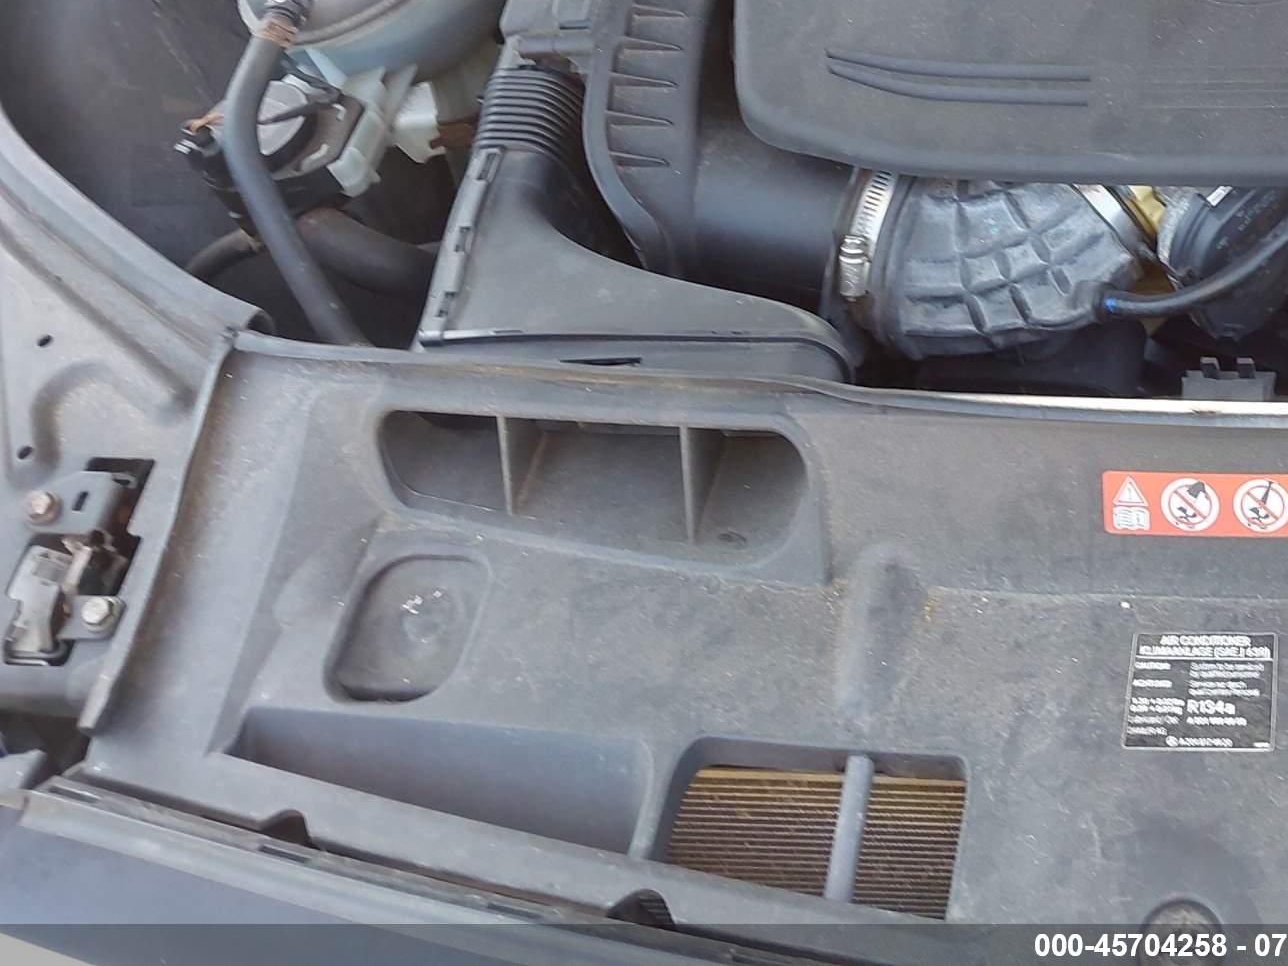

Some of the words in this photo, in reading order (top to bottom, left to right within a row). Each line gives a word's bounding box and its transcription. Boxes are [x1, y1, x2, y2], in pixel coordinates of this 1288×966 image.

[1160, 635, 1180, 646] AIR
[1180, 635, 1251, 647] CONDITIONER
[1186, 698, 1236, 716] R134a
